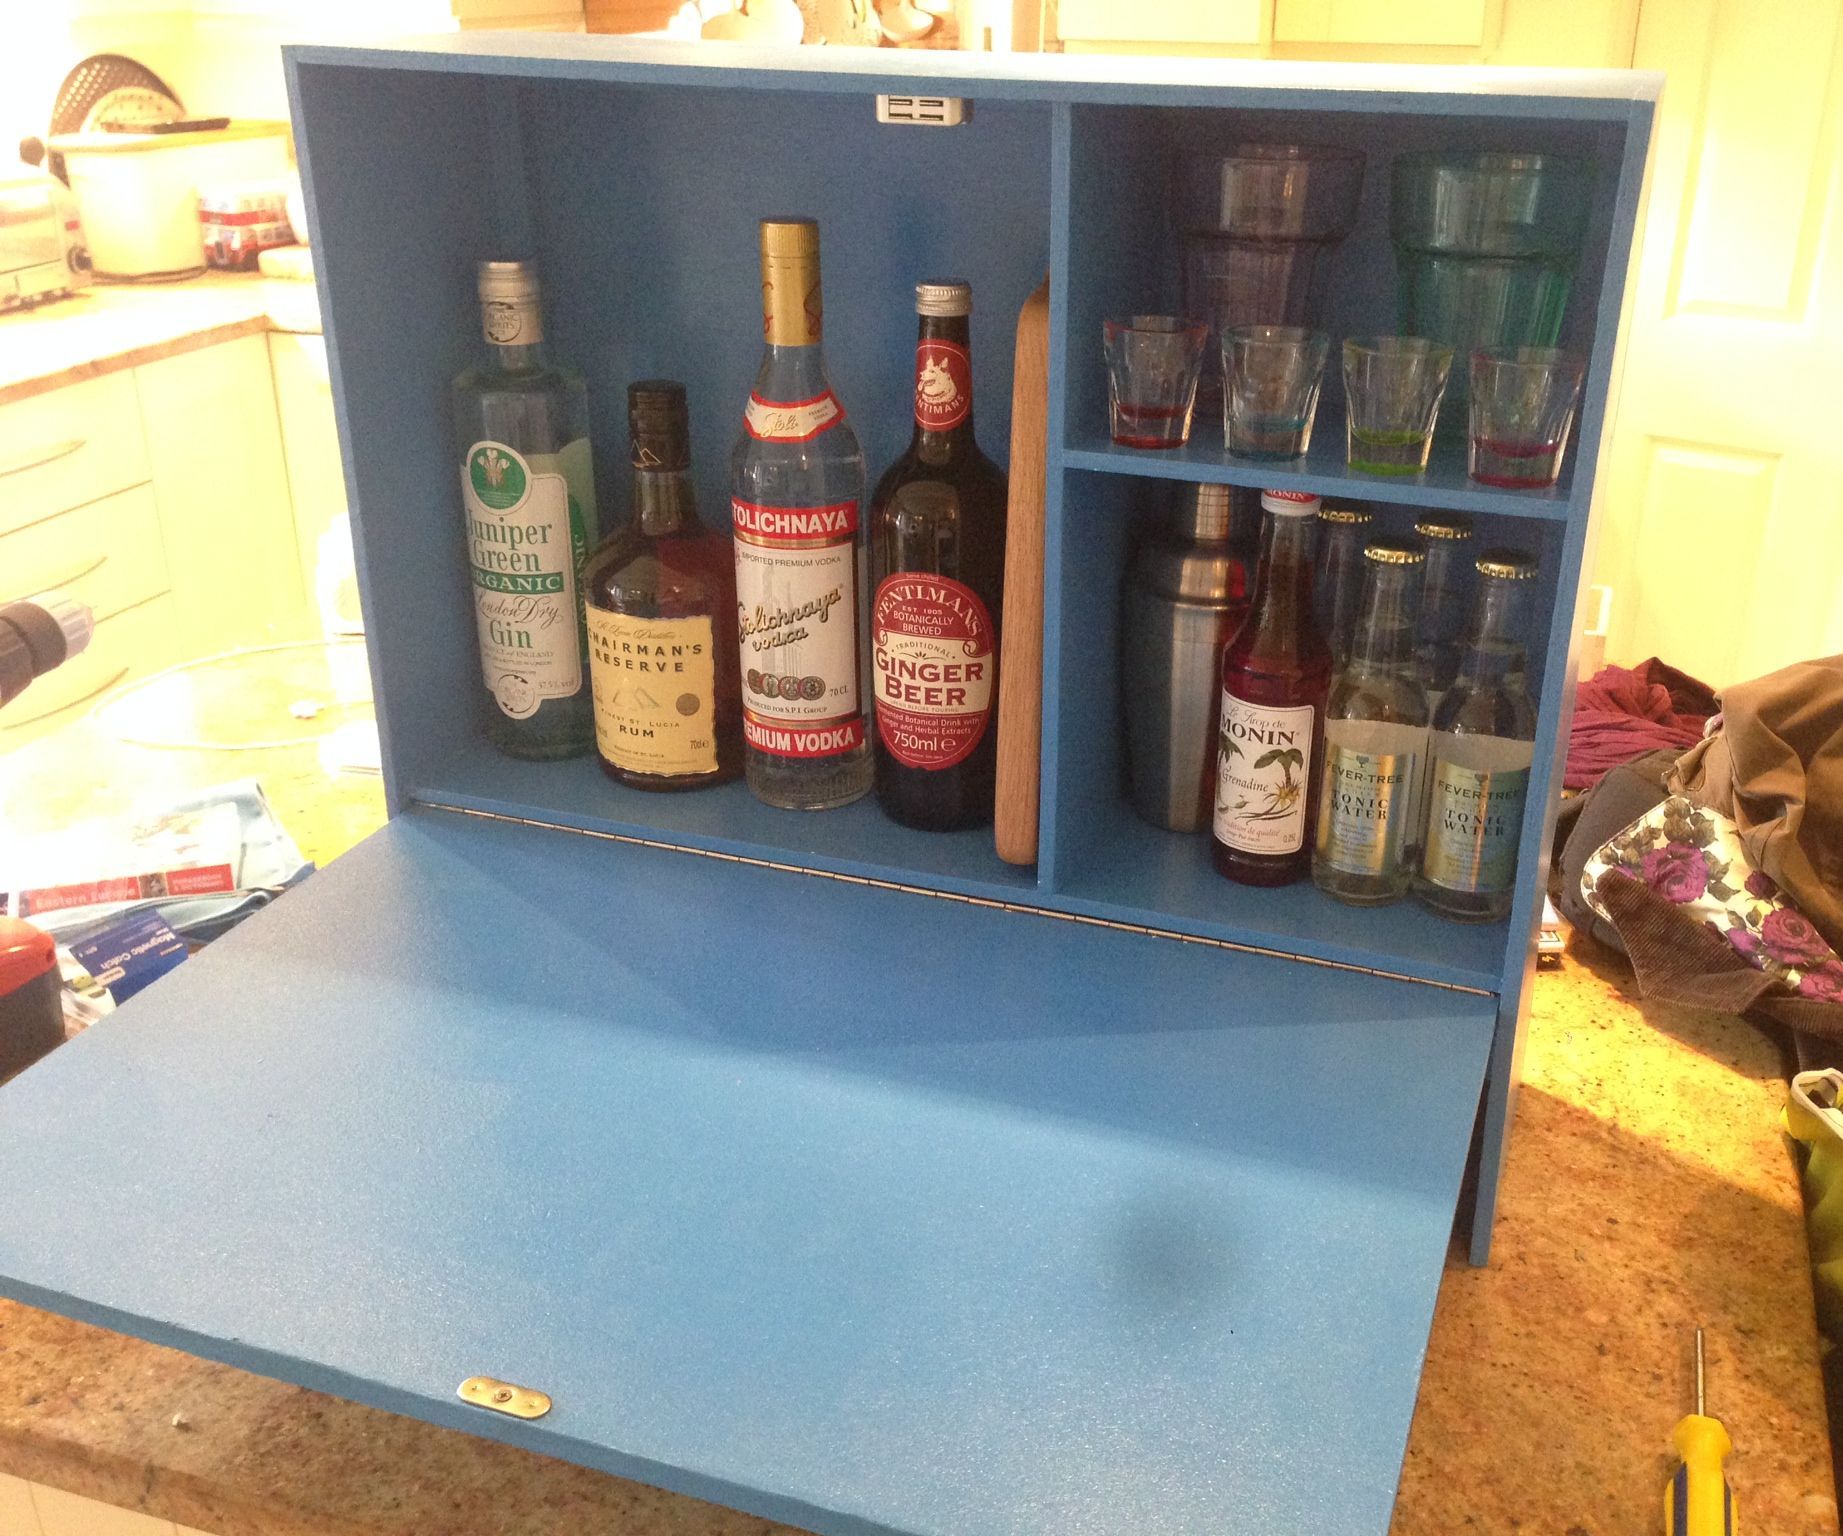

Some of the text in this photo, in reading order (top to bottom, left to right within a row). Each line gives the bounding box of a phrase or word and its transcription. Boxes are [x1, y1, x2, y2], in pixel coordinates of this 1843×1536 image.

[916, 394, 964, 415] NTIMANS
[1269, 489, 1305, 500] ONIN
[467, 508, 552, 550] Juniper
[732, 502, 848, 534] TOLICHNAYA
[473, 539, 542, 572] Green
[775, 559, 813, 567] PREMIUM
[815, 556, 841, 567] VODKA
[473, 566, 560, 590] RGANIC
[513, 595, 563, 630] Dry
[738, 588, 842, 644] Stolichnaya
[878, 585, 981, 636] FENTIMANS
[893, 610, 954, 625] BOTANICALLY
[489, 620, 533, 649] Gin
[752, 627, 809, 652] vodka
[902, 623, 942, 636] BREWED
[588, 628, 702, 657] CHAIRMAN'S
[895, 641, 952, 658] TRADITIONAL
[595, 648, 684, 673] RESERVE
[876, 646, 984, 683] GINGER
[885, 673, 966, 707] BEER
[900, 722, 913, 732] and
[915, 725, 939, 735] Herbal
[941, 727, 971, 736] Extracts
[905, 713, 939, 727] Botanical
[940, 719, 961, 727] Drink
[1221, 713, 1296, 746] MONIN
[1226, 706, 1287, 730] Le Sirop de
[619, 724, 655, 738] RUM
[744, 720, 855, 752] EMIUM VODKA
[893, 730, 937, 752] 750ml
[1222, 765, 1270, 793] Grenadine
[1326, 760, 1405, 784] FEVER-TREE
[1331, 799, 1387, 820] WATER
[1333, 789, 1389, 809] TONIC
[1444, 819, 1504, 836] WATER
[1445, 807, 1505, 825] TONIC
[130, 932, 176, 956] Magnetic
[100, 952, 132, 970] Catch
